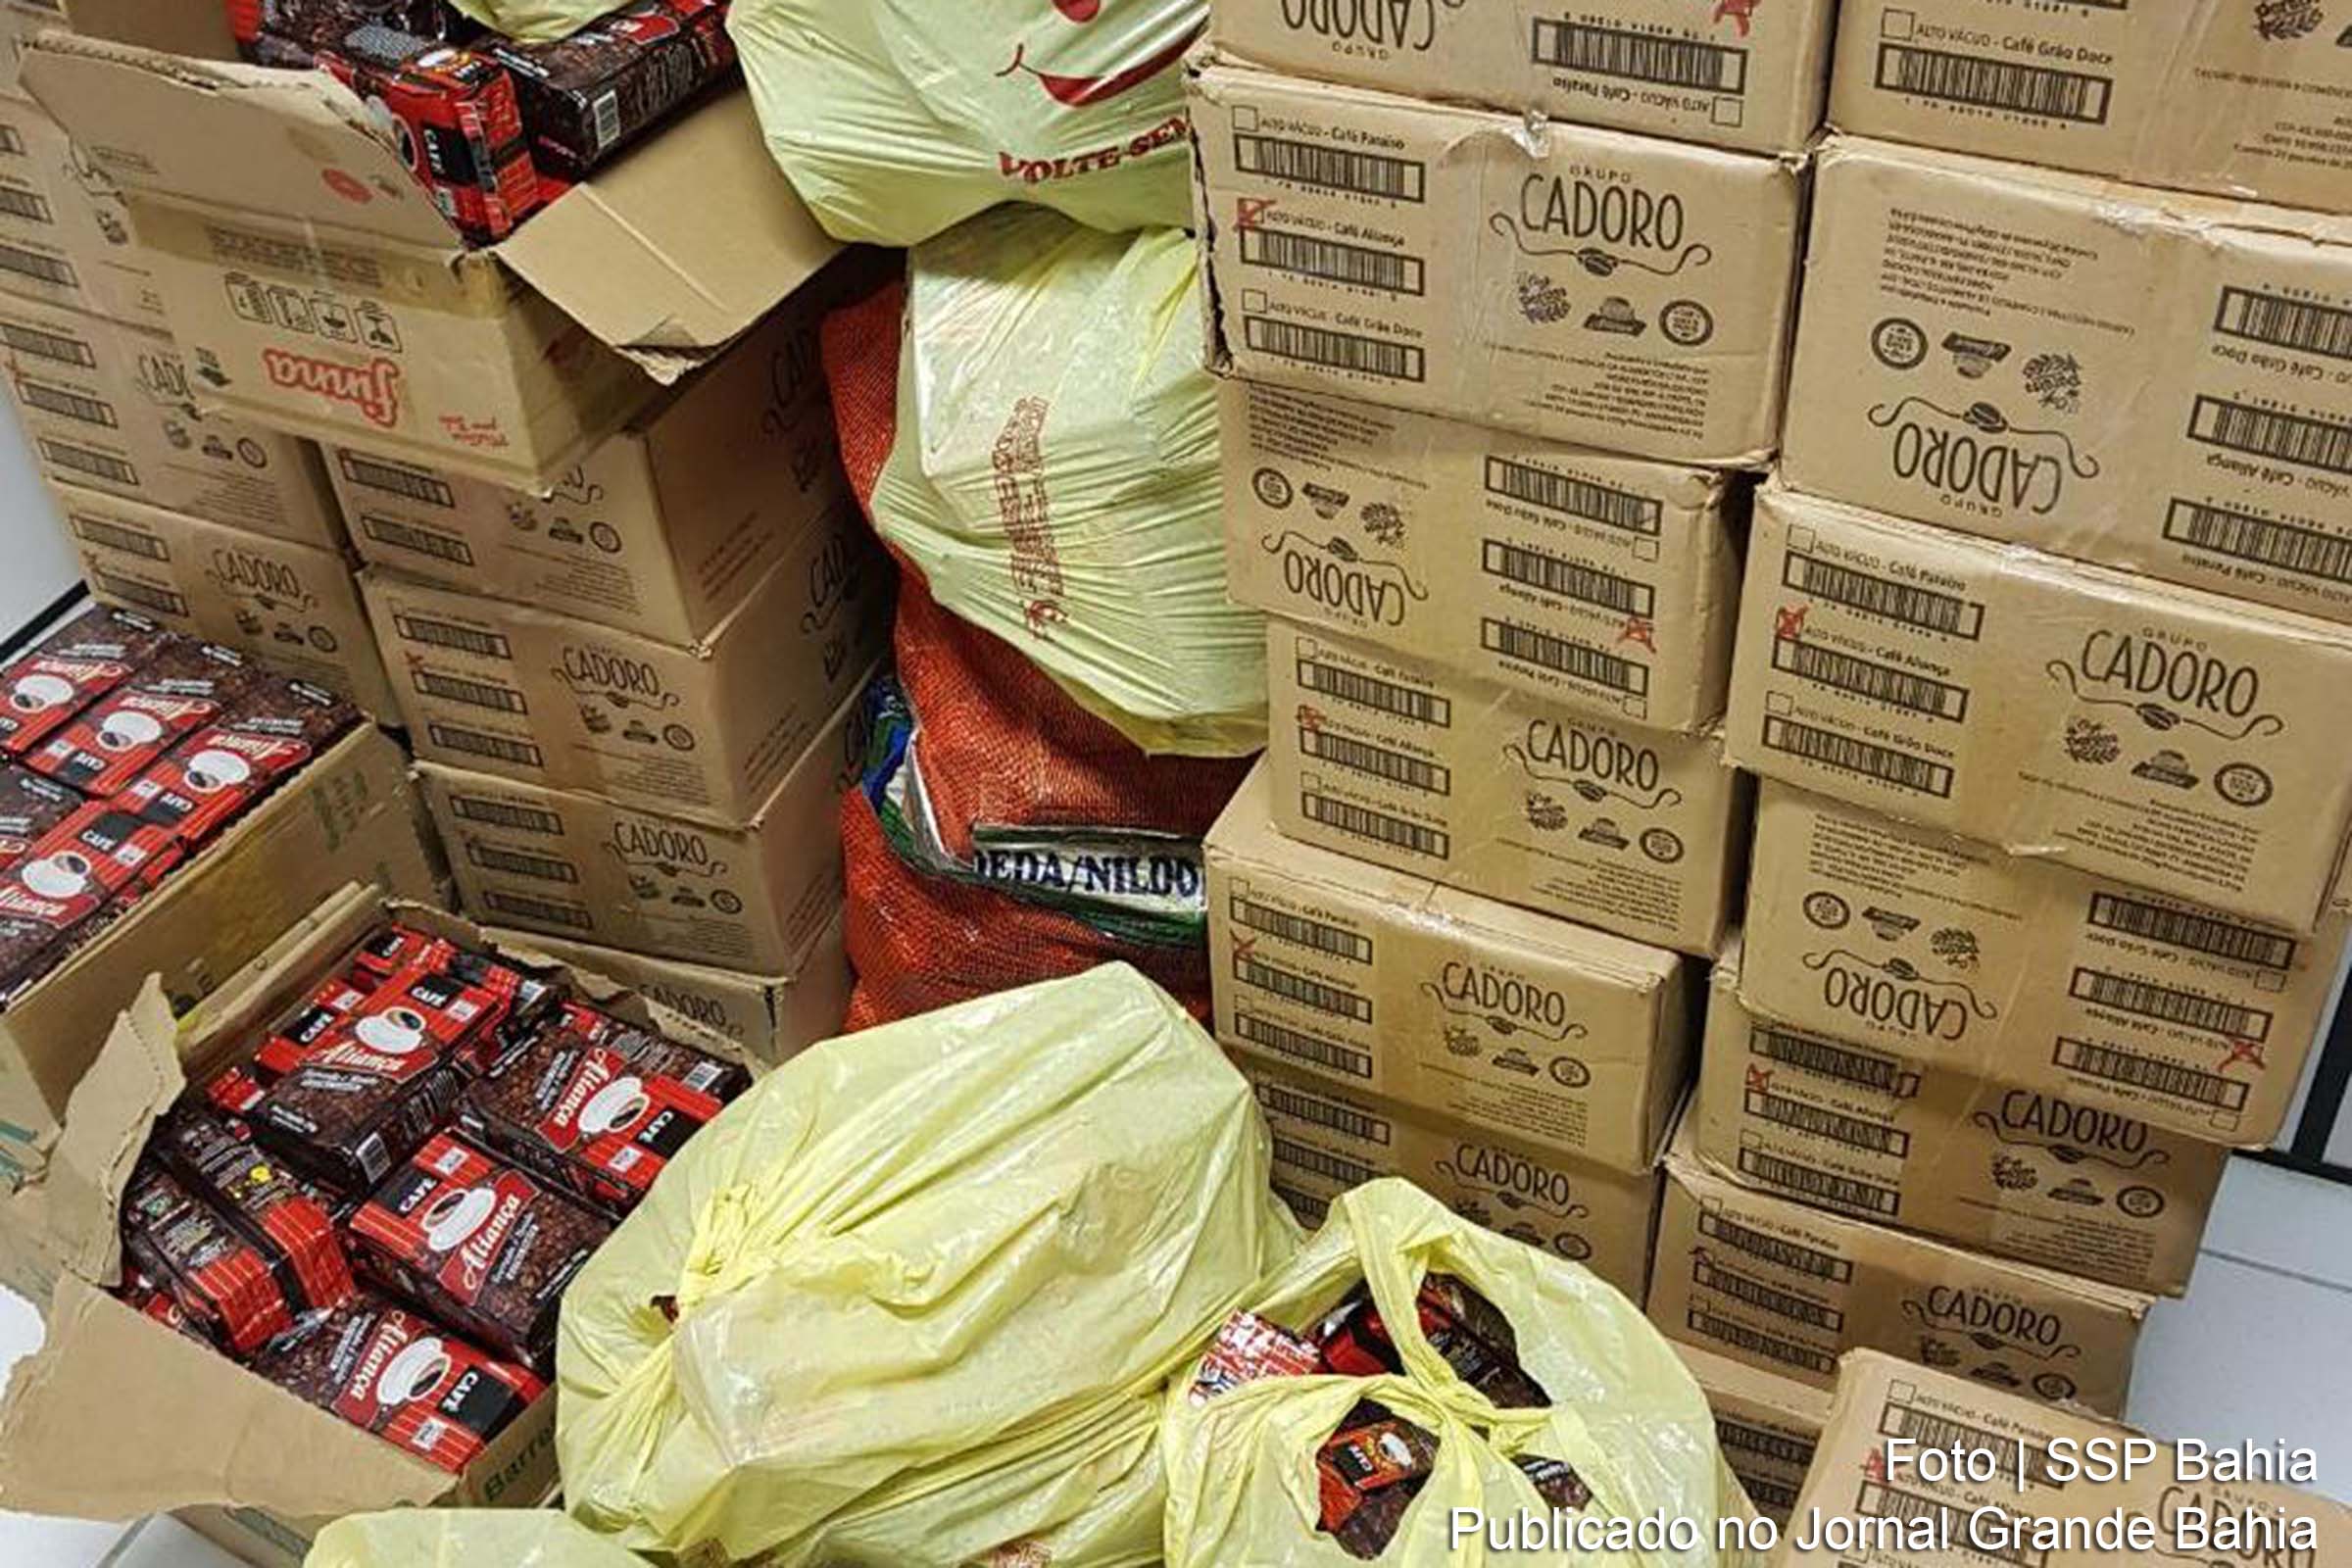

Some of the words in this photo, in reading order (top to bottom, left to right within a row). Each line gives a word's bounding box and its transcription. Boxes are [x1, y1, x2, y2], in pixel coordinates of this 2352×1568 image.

[1916, 22, 1945, 41] ALTO
[2002, 35, 2034, 54] Café
[1570, 164, 1632, 183] GRUPO
[1521, 172, 1684, 251] CADORO
[2290, 362, 2323, 381] Café
[1893, 421, 2061, 514] CADORO
[1284, 549, 1405, 626] CADORO
[1888, 561, 1917, 580] Café
[563, 646, 661, 697] CADORO
[2082, 629, 2260, 718] CADORO
[1528, 719, 1658, 791] CADORO
[612, 820, 709, 866] CADORO
[1443, 962, 1565, 1026] CADORO
[1825, 966, 1968, 1041] CADORO
[552, 1048, 612, 1128] Aliança
[2002, 1090, 2149, 1153] CADORO
[1454, 1143, 1570, 1206] CADORO
[460, 1193, 521, 1291] Aliança
[1929, 1285, 2062, 1346] CADORO
[350, 1309, 410, 1401] Aliança
